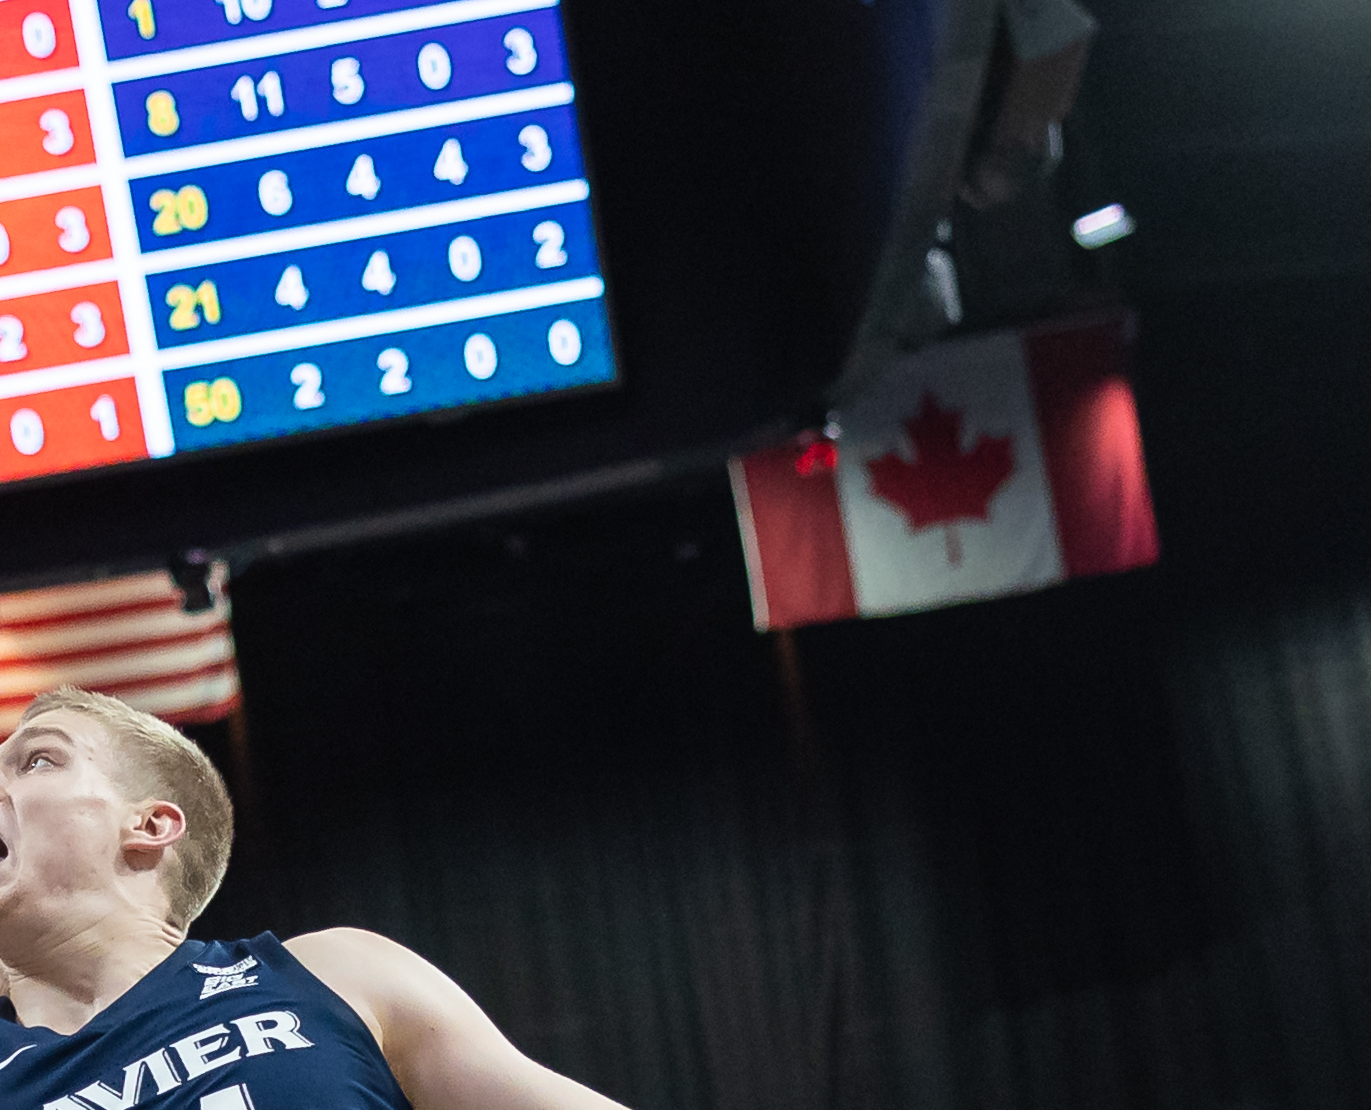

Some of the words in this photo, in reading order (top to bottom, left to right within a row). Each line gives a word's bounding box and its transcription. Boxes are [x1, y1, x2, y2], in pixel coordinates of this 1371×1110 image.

[22, 11, 56, 59] 0
[145, 90, 179, 136] 8
[230, 71, 285, 121] 11
[330, 57, 364, 105] 5
[417, 42, 451, 90] 0
[503, 27, 537, 75] 3
[39, 108, 74, 156] 3
[149, 185, 208, 235] 20
[257, 169, 292, 216] 6
[346, 154, 381, 200] 4
[433, 138, 468, 185] 4
[518, 124, 552, 172] 3
[54, 206, 90, 253] 3
[165, 280, 221, 331] 21
[275, 265, 309, 310] 4
[362, 250, 396, 295] 4
[448, 235, 482, 282] 0
[532, 221, 567, 269] 2
[70, 301, 106, 348] 3
[184, 377, 242, 427] 50
[290, 363, 324, 410] 2
[377, 348, 412, 395] 2
[464, 333, 498, 380] 0
[548, 319, 582, 366] 0
[9, 408, 45, 456] 0
[90, 394, 120, 441] 1
